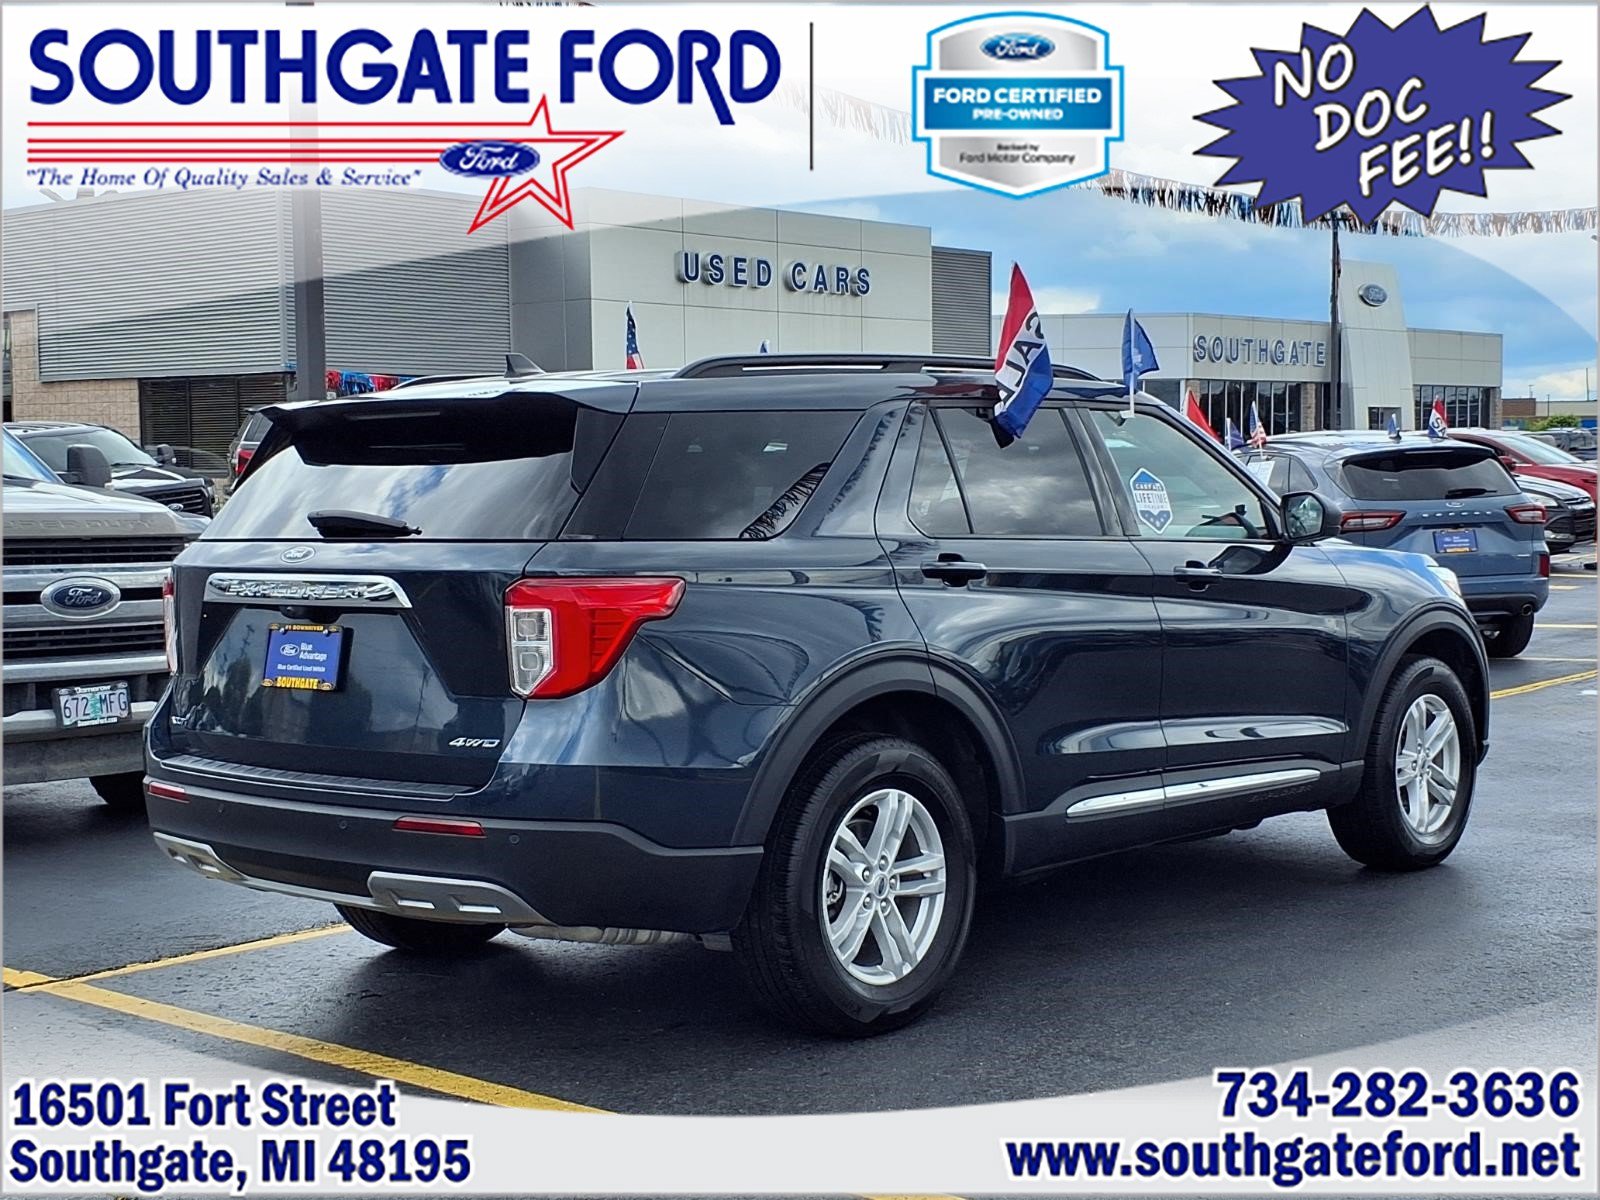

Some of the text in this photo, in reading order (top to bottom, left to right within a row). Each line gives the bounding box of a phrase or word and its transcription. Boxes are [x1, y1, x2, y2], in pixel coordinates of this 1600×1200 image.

[679, 251, 871, 297] USED CARS
[1194, 334, 1327, 367] SOUTHGATE
[64, 586, 103, 606] Ford
[225, 578, 361, 600] EXPLORER
[300, 642, 313, 651] Blue
[299, 652, 328, 662] Advantage
[276, 676, 319, 690] SOUTHGATE
[63, 691, 128, 719] 672 MFG
[448, 737, 501, 748] 4WD
